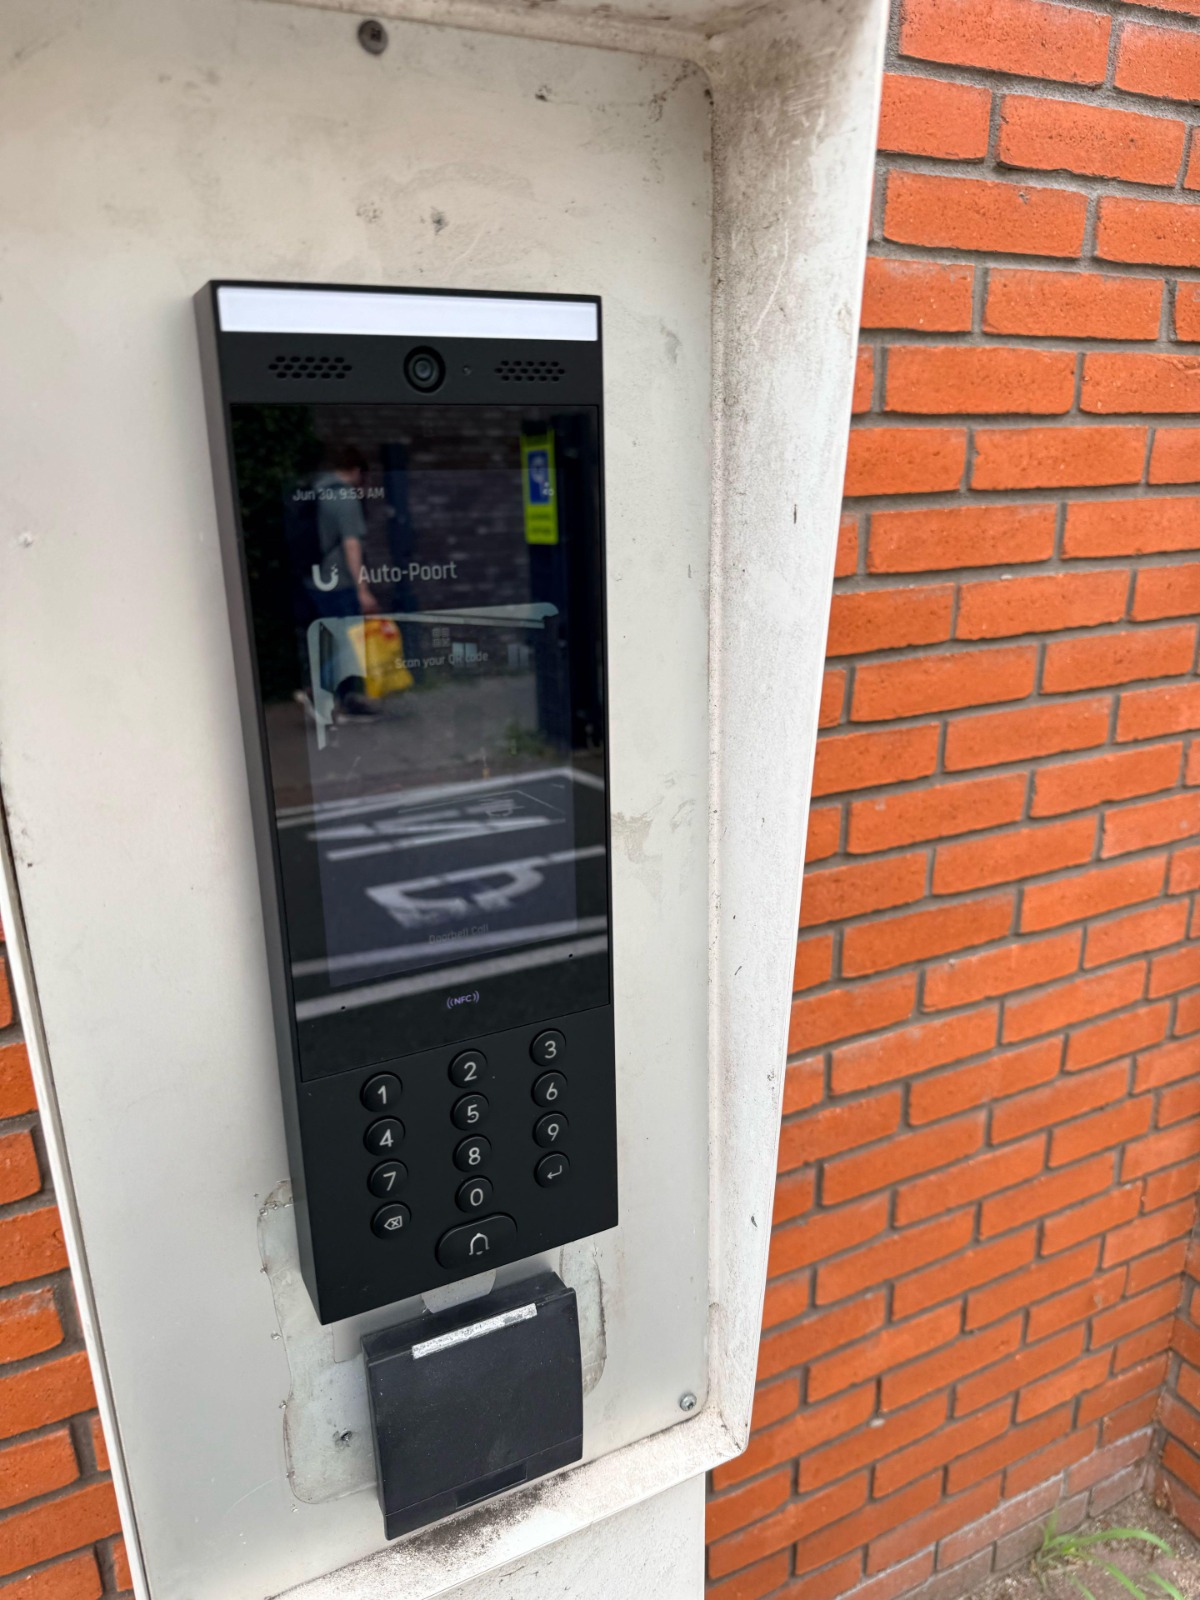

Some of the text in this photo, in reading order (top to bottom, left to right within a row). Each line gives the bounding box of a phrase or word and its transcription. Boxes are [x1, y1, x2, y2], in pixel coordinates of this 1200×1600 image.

[292, 488, 316, 501] Jun
[367, 486, 385, 499] AM
[358, 561, 458, 584] Auto-Poort
[394, 657, 421, 669] Scan
[422, 655, 446, 668] your
[454, 994, 472, 1006] NFC
[544, 1040, 557, 1058] 3
[464, 1061, 477, 1081] 2
[377, 1085, 387, 1104] 1
[546, 1082, 558, 1100] 6
[467, 1104, 480, 1123] 5
[379, 1129, 394, 1147] 4
[547, 1123, 559, 1141] 9
[468, 1147, 481, 1165] 8
[383, 1171, 396, 1191] 7
[470, 1188, 484, 1206] 0
